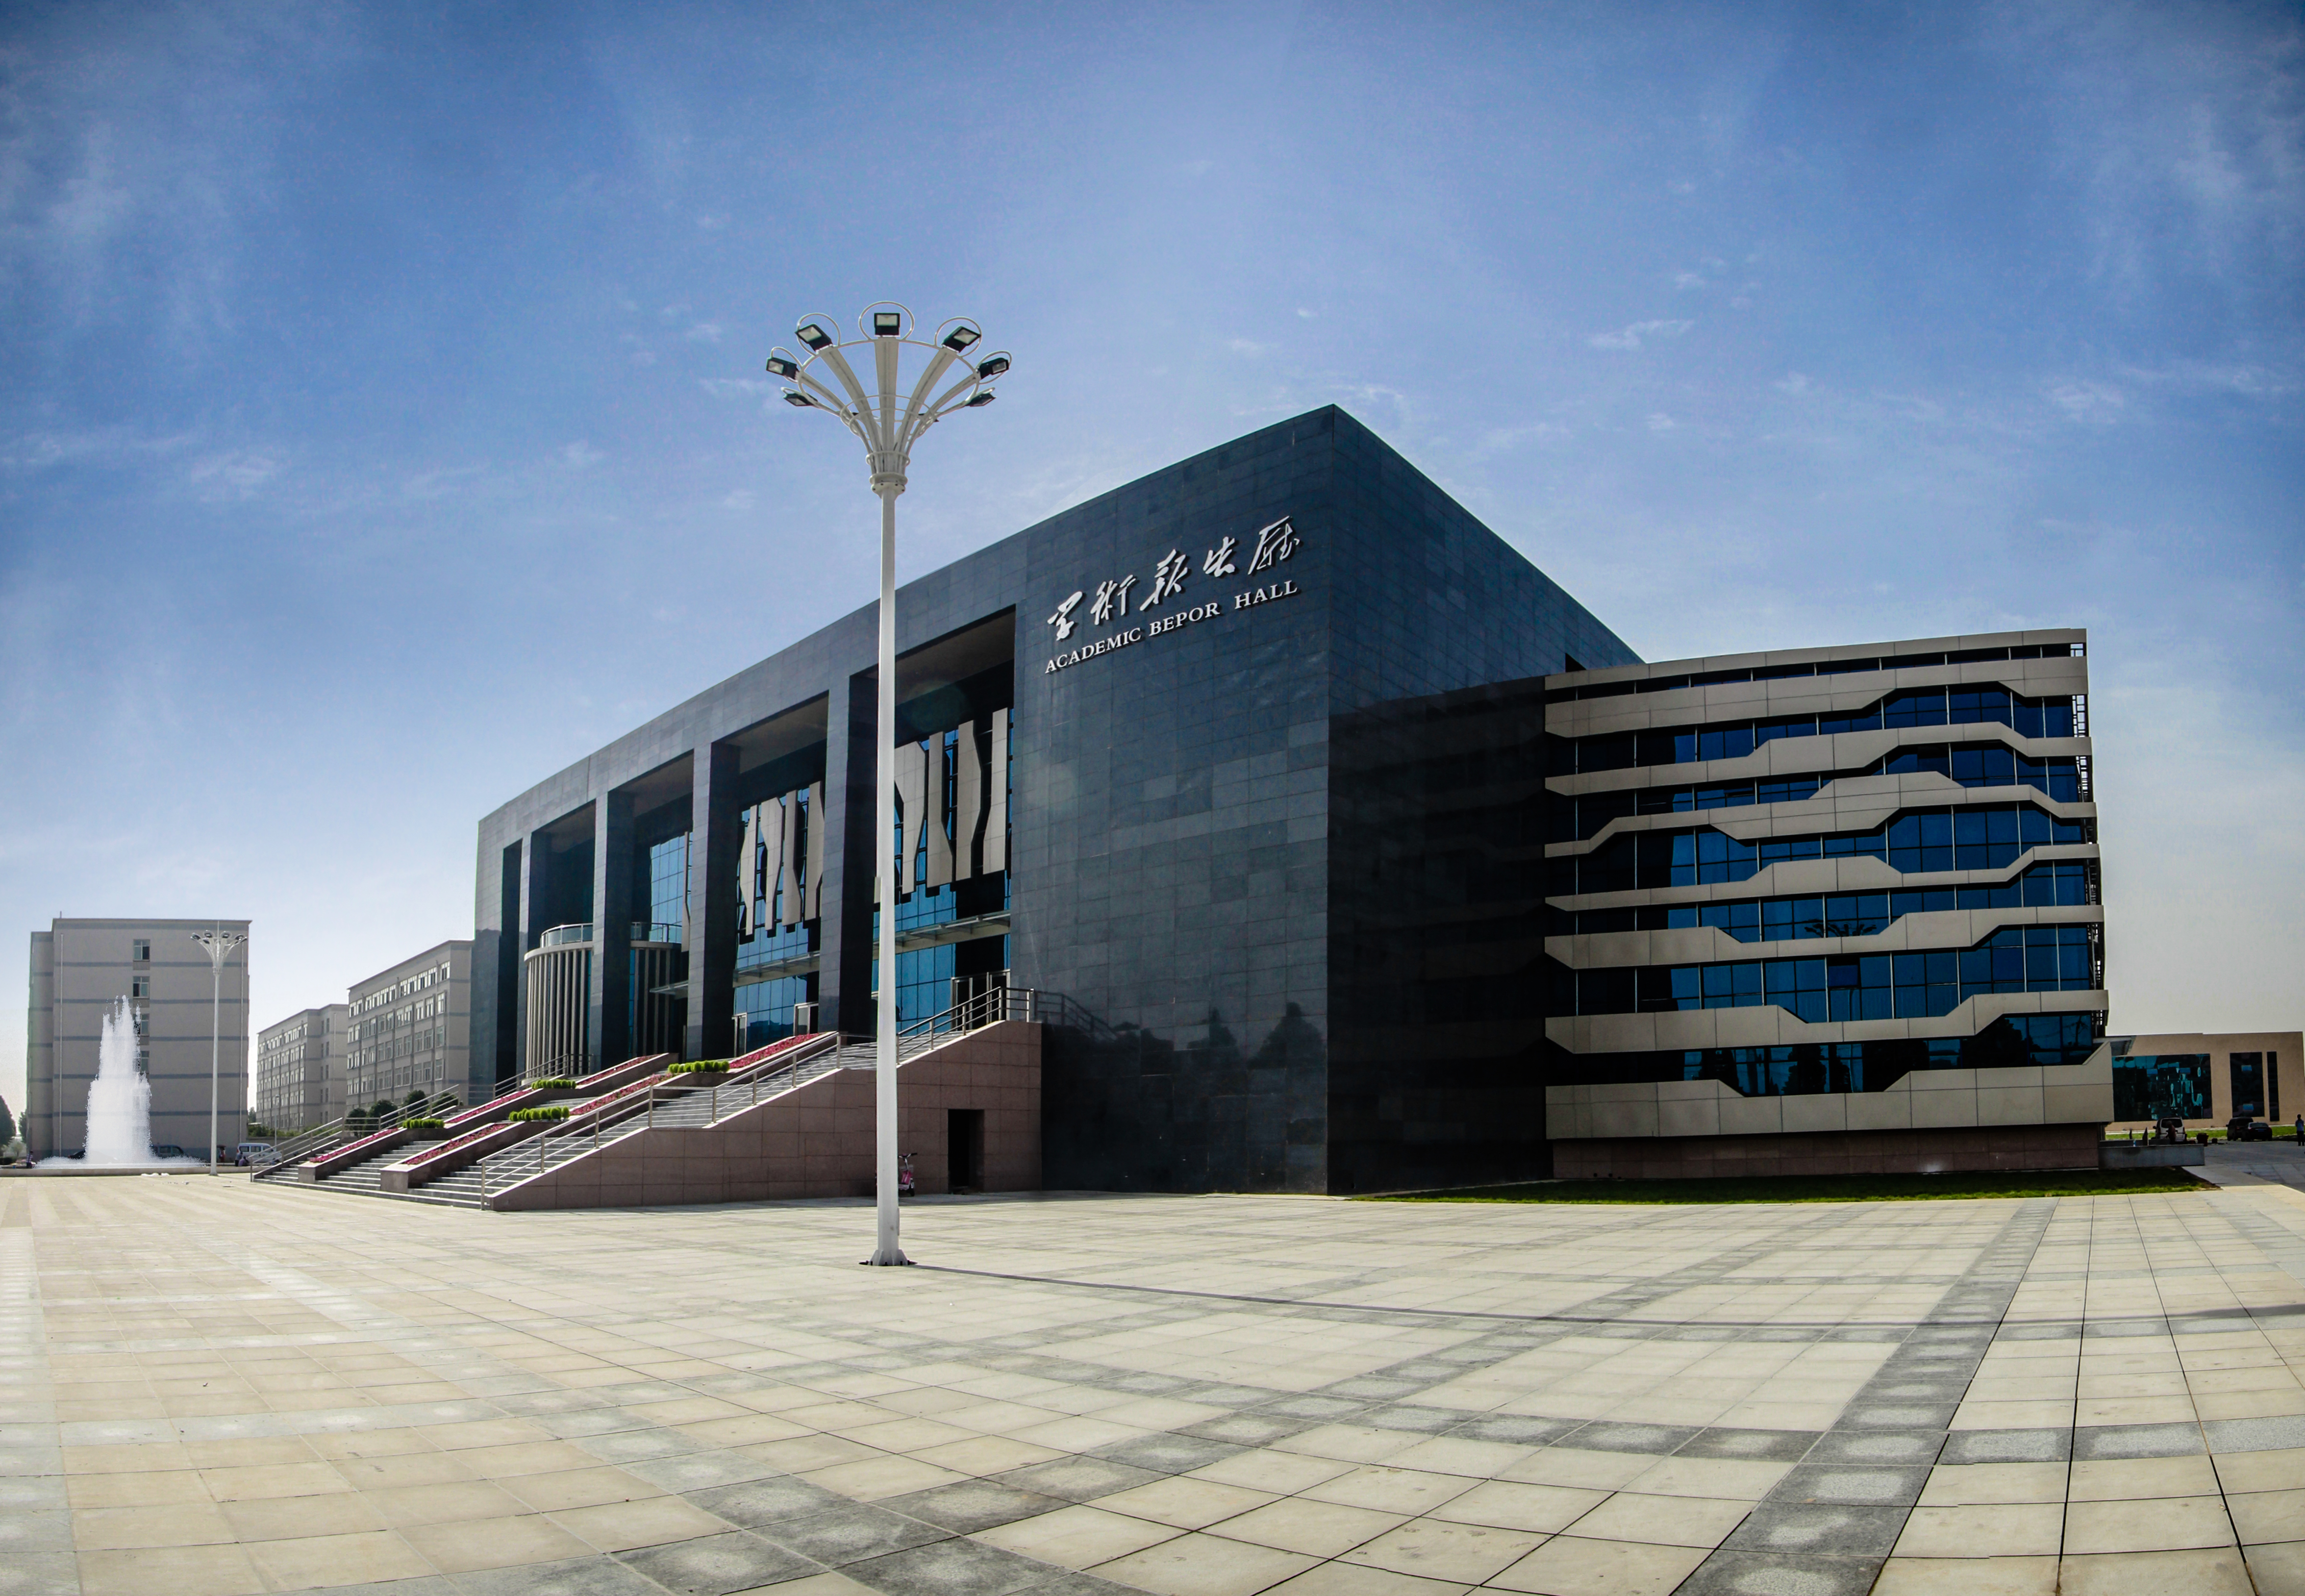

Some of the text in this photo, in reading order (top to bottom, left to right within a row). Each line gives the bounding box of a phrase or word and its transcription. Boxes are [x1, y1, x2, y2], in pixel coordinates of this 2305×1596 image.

[1045, 580, 1298, 674] ACADEMIC BEPOR HALL
